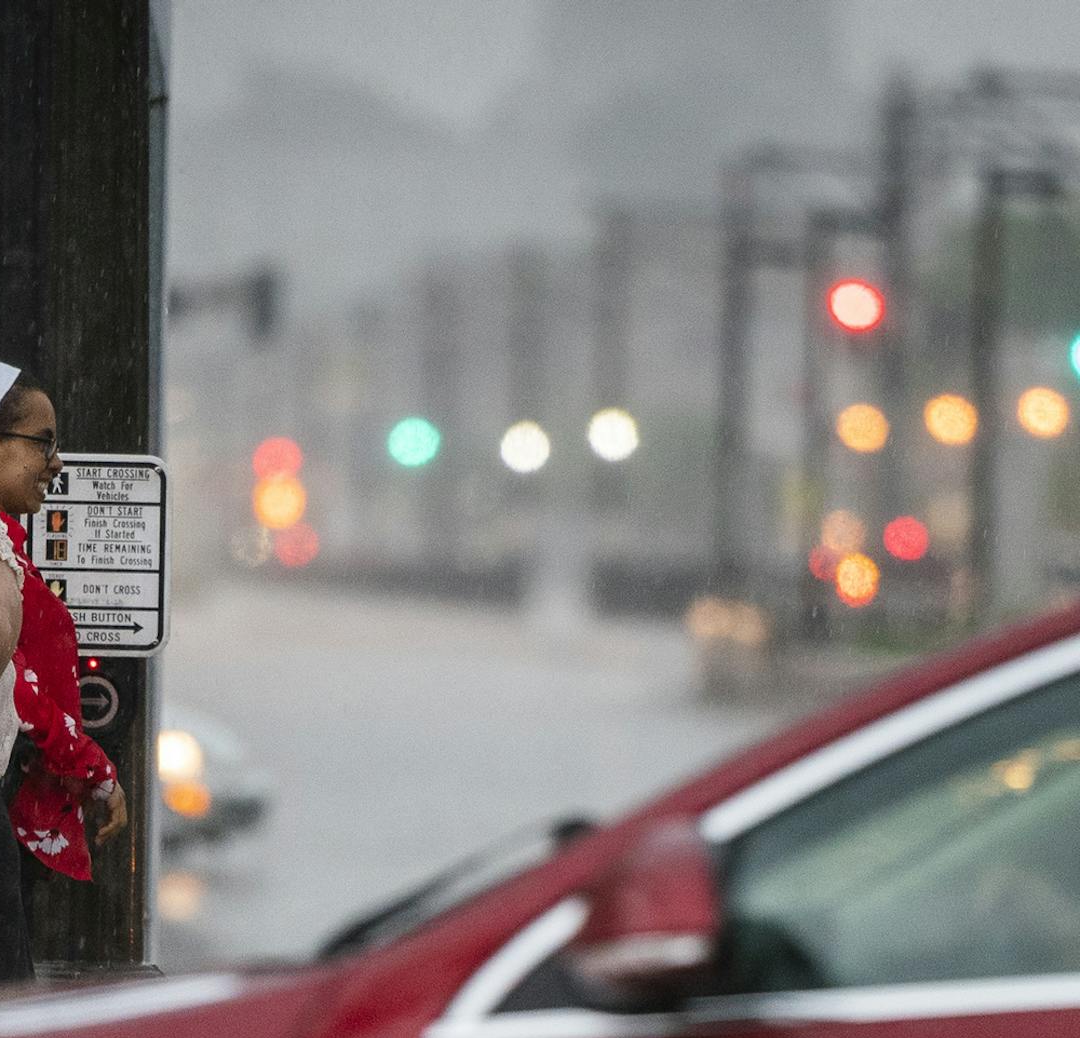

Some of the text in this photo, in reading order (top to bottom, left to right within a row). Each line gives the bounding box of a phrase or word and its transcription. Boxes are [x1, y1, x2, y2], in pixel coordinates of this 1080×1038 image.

[76, 467, 150, 480] START CROSSING
[92, 480, 134, 491] Watch For
[97, 491, 130, 501] Vehicles
[87, 506, 144, 517] DON'T START
[84, 519, 146, 532] Finish Crossing
[94, 529, 136, 540] If Started
[78, 542, 152, 554] TIME REMAINING
[77, 554, 86, 565] To
[91, 554, 115, 566] Finish
[120, 555, 153, 568] Crossing
[82, 584, 141, 596] DON'T CROSS
[72, 612, 132, 623] SH BUTTON
[86, 631, 121, 642] CROSS
